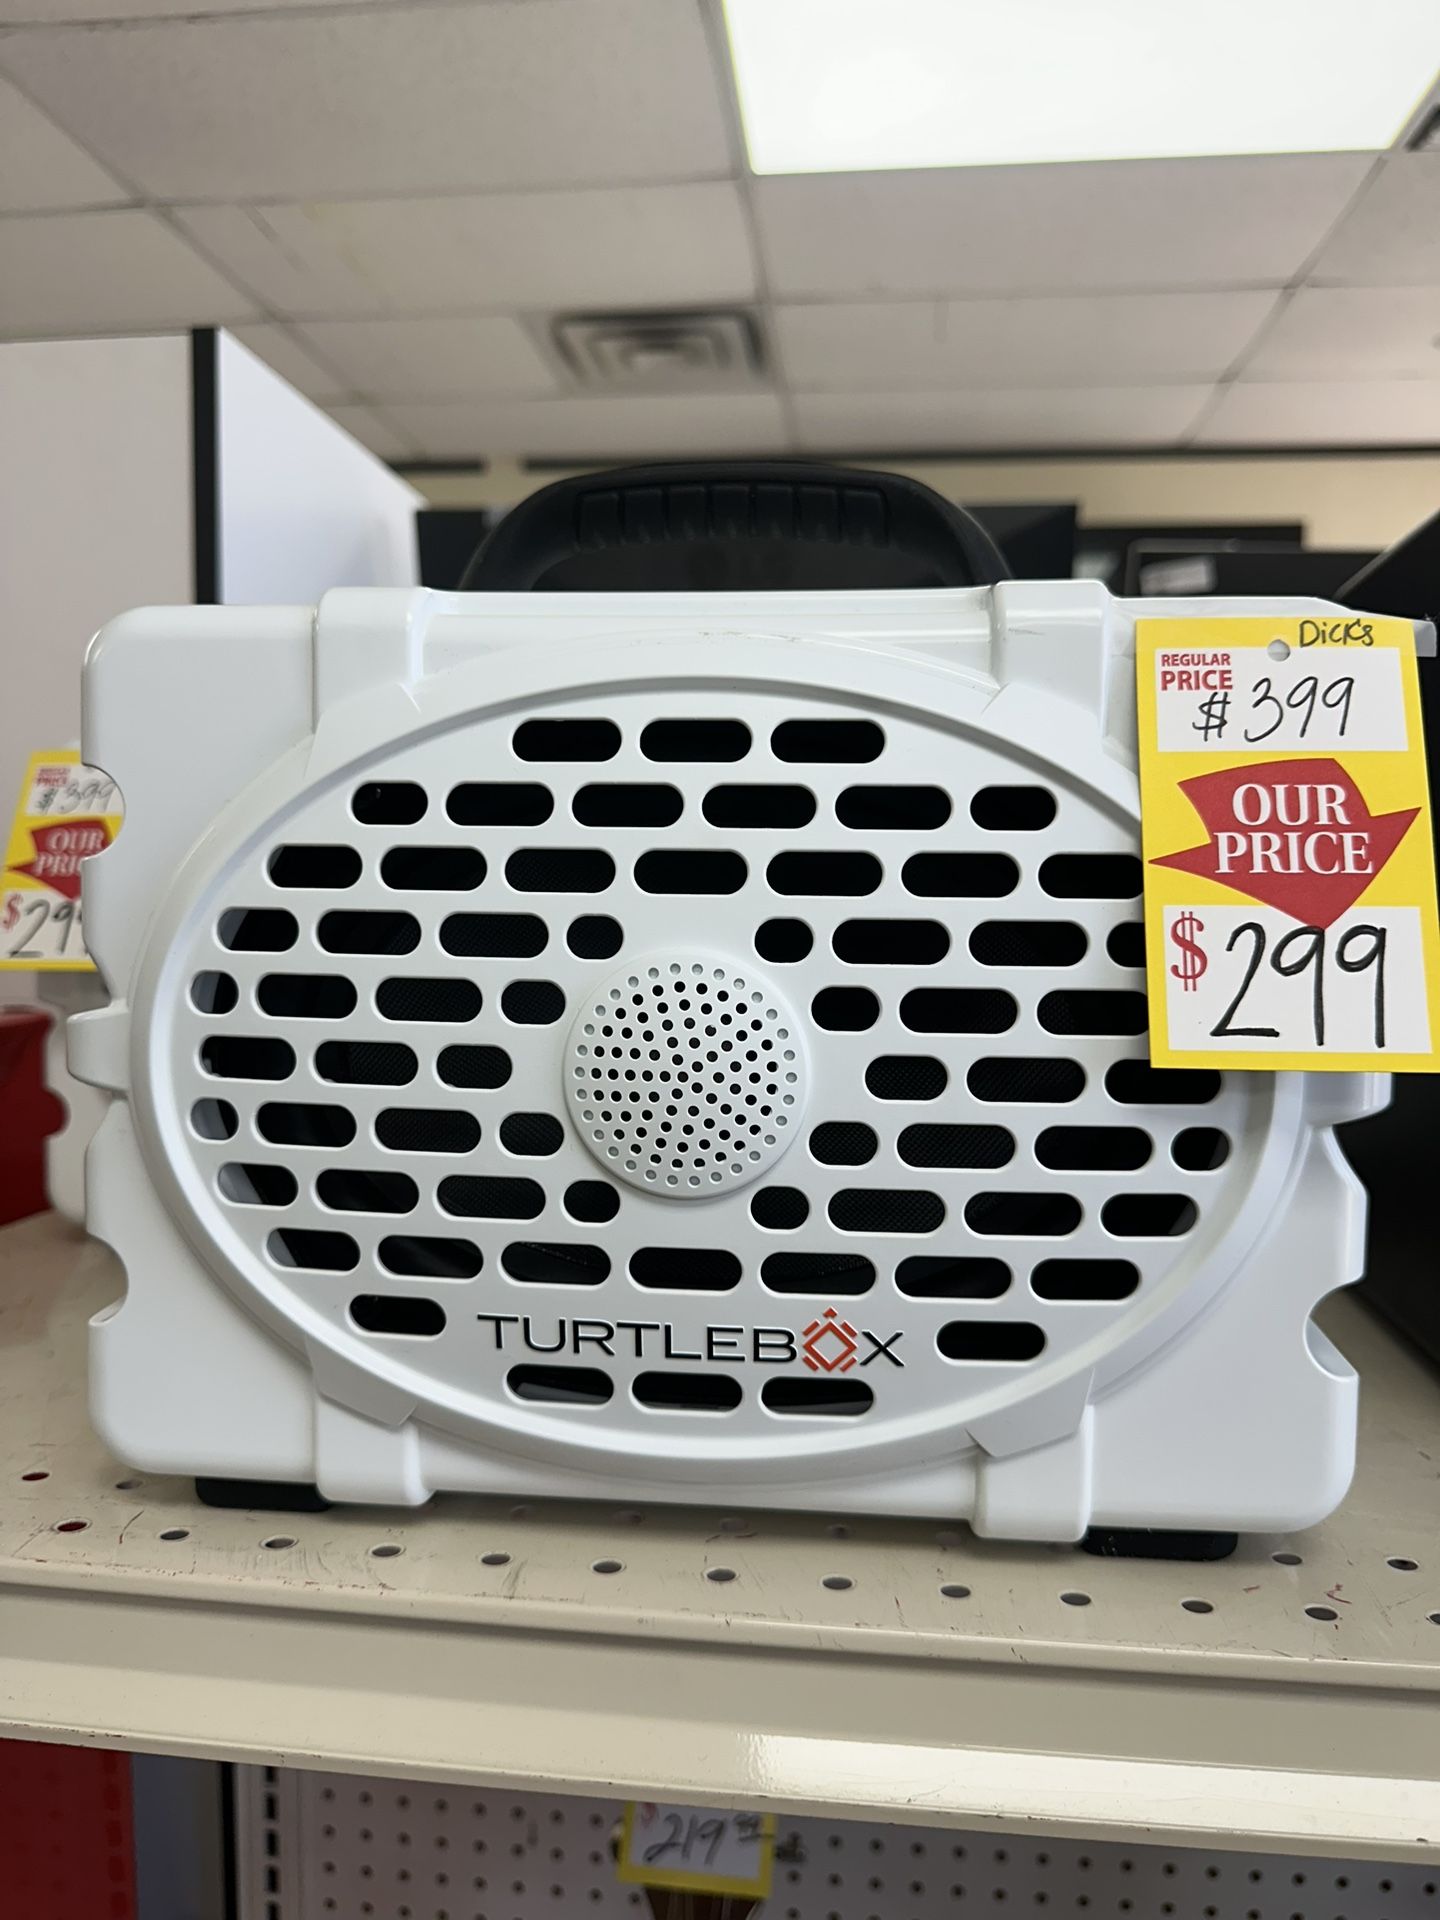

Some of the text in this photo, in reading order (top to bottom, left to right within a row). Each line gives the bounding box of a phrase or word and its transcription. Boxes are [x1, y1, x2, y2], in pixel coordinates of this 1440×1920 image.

[1160, 653, 1231, 667] REGULAR
[1160, 669, 1233, 692] PRICE
[1231, 782, 1352, 826] OUR
[47, 827, 105, 853] OUR
[1212, 831, 1374, 875] PRICE
[477, 1306, 905, 1373] TURTLEBOX
